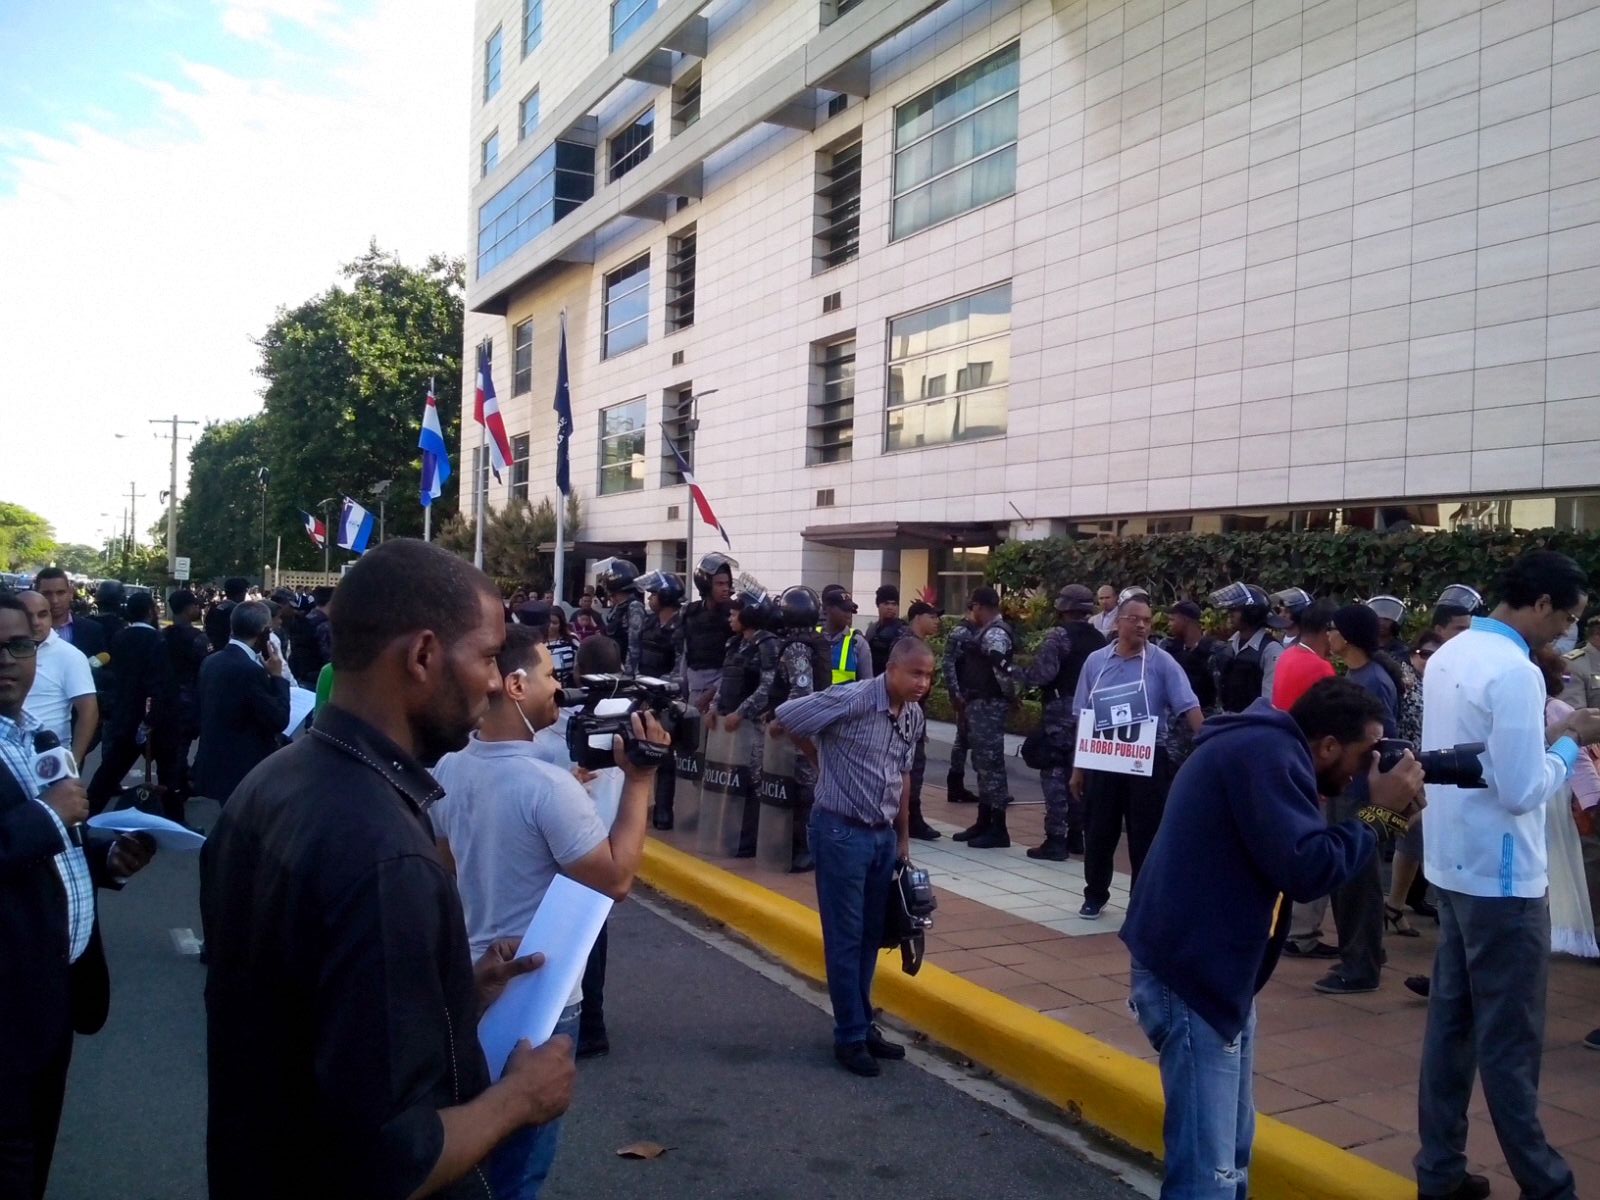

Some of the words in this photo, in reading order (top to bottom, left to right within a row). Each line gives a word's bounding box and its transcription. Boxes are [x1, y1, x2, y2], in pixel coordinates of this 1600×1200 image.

[1079, 738, 1089, 752] AL
[1090, 739, 1113, 755] ROBO
[1114, 742, 1152, 760] PUBLICO
[704, 767, 740, 788] POLICÍA
[762, 779, 787, 800] LICÍA
